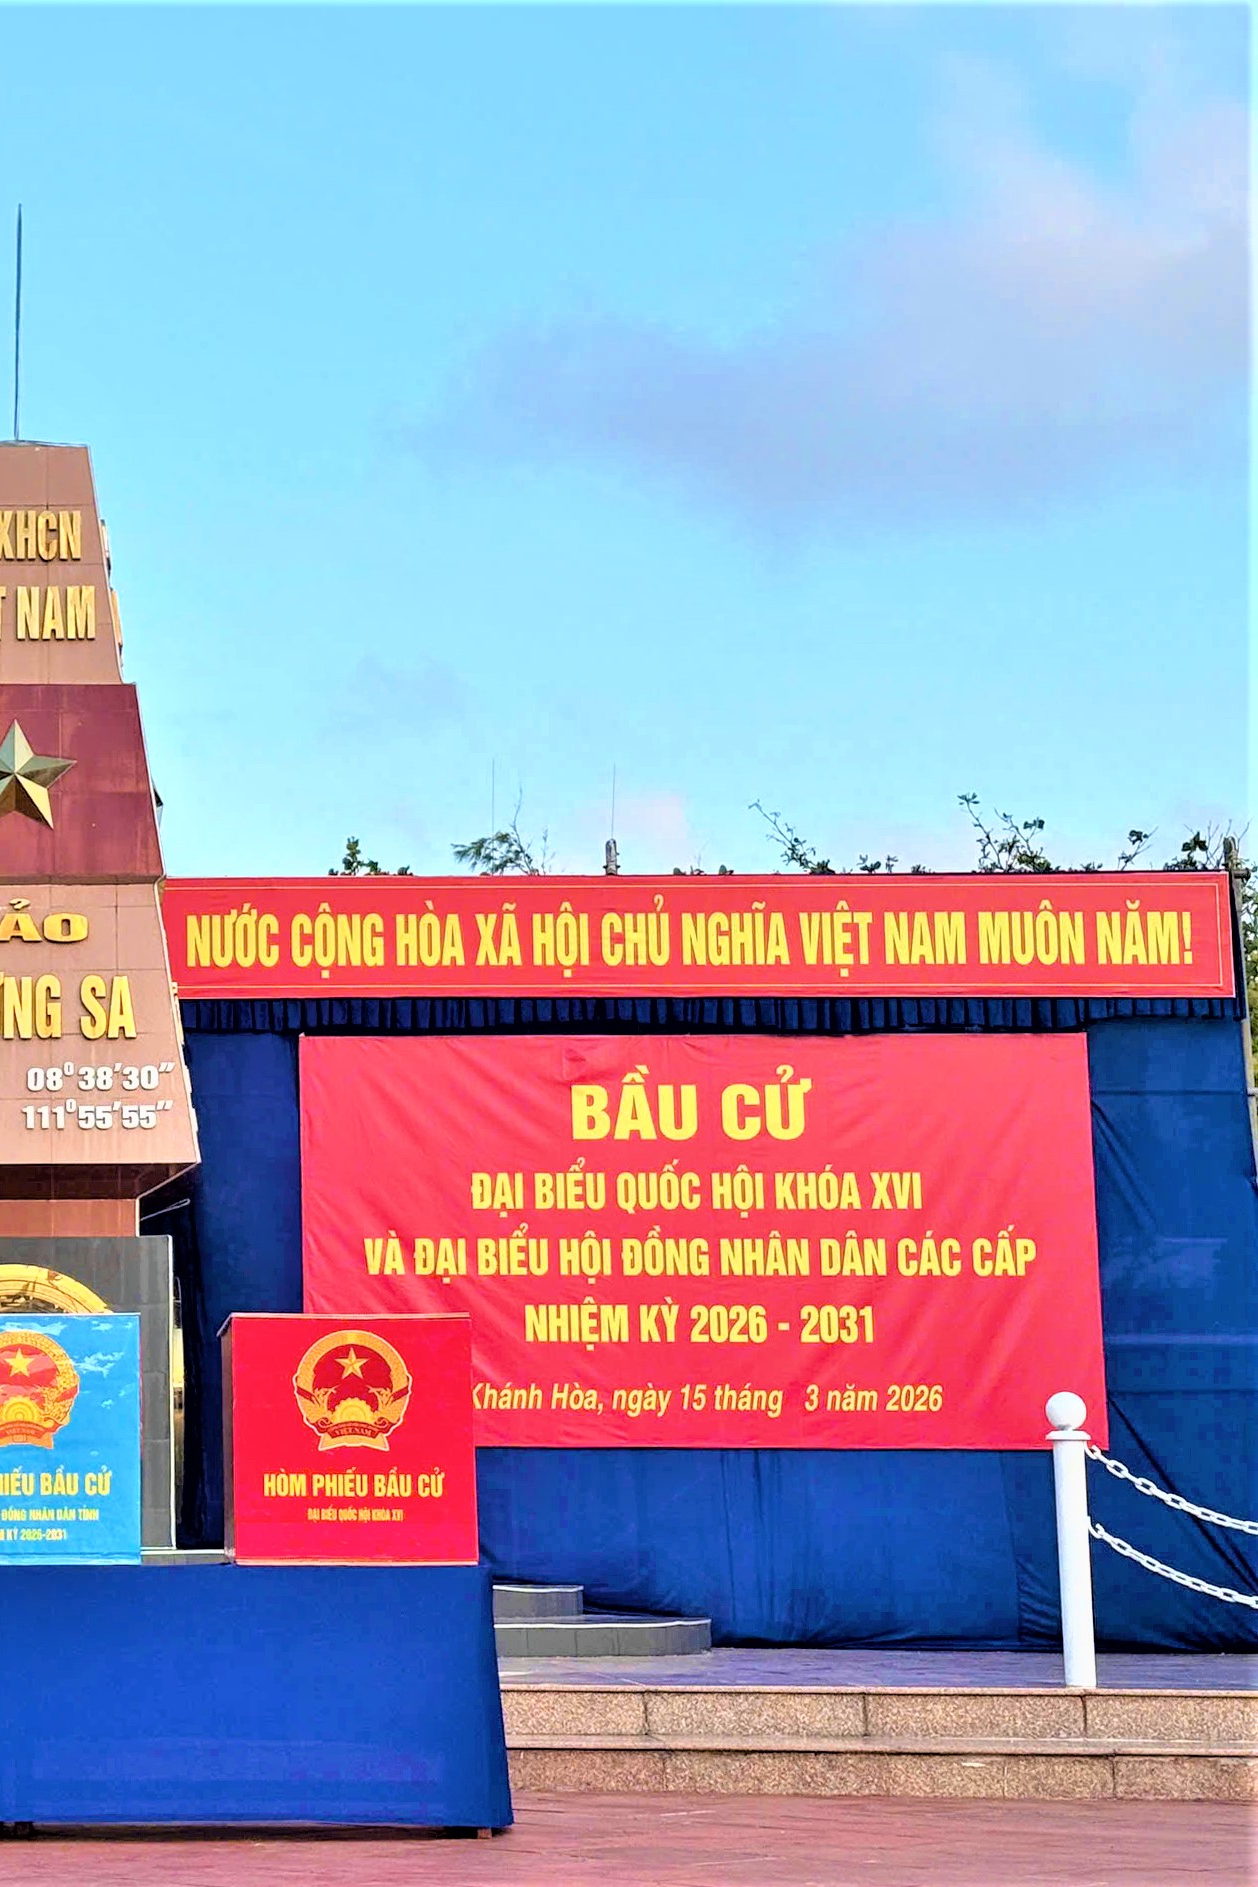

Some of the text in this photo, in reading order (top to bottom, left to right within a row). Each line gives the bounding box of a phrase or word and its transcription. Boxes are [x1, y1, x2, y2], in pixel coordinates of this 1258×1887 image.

[16, 585, 96, 641] NAM
[186, 895, 1193, 978] NƯỚC CỘNG HÒA XÃ HỘI CHỦ NGHĨA VIỆT NAM MUÔN NĂM!
[80, 974, 138, 1041] SA
[571, 1064, 813, 1141] BẦU CỬ
[471, 1158, 922, 1218] ĐẠI BIỂU QUỐC HỘI KHÓA XVI
[363, 1224, 1037, 1284] VÀ ĐẠI BIỂU HỘI ĐỒNG NHÂN DÂN CÁC CẤP
[524, 1296, 629, 1351] NHIỆM
[639, 1297, 680, 1343] KỲ
[690, 1304, 768, 1344] 2026
[800, 1304, 874, 1344] 2031
[551, 1383, 604, 1414] Hòa,
[612, 1384, 671, 1418] ngày
[680, 1384, 707, 1411] 15
[714, 1383, 783, 1418] tháng
[804, 1384, 819, 1411] 3
[826, 1383, 878, 1412] năm
[885, 1384, 943, 1412] 2026
[84, 1465, 113, 1497] CỬ
[263, 1468, 307, 1498] HÒM
[312, 1466, 368, 1498] PHIẾU
[417, 1466, 445, 1498] CỬ
